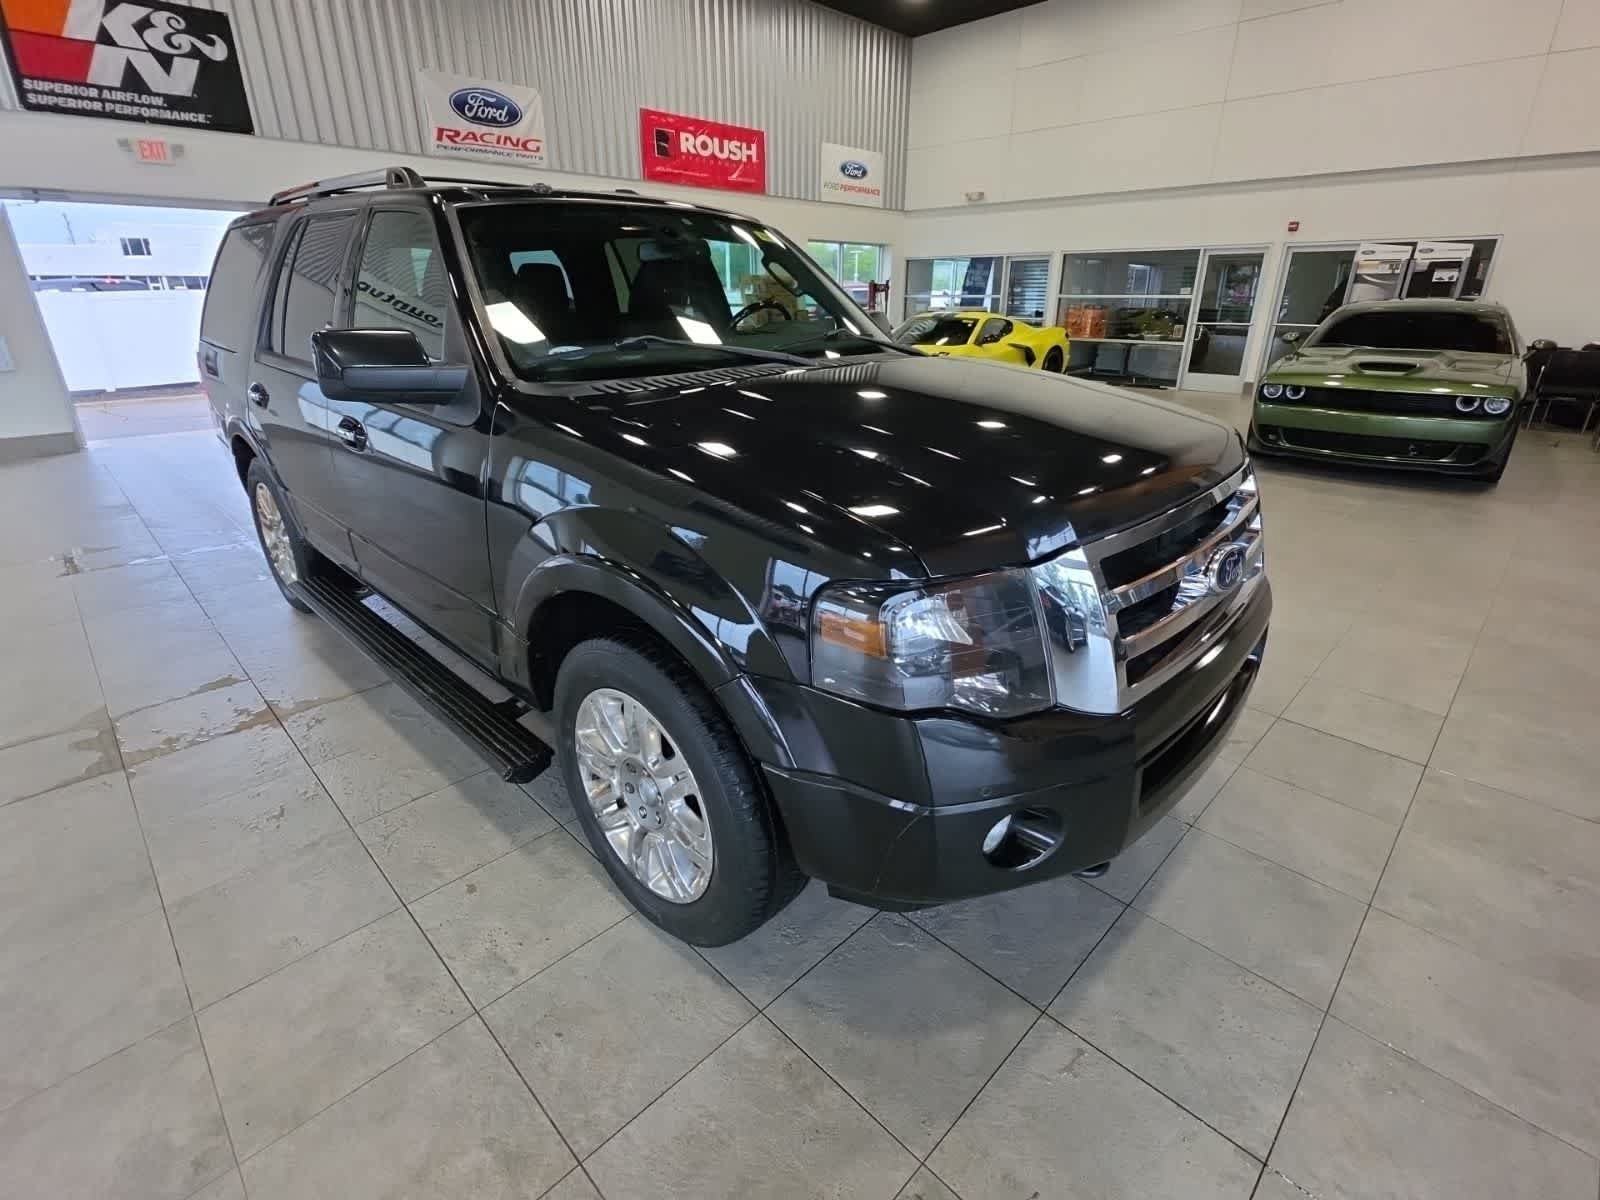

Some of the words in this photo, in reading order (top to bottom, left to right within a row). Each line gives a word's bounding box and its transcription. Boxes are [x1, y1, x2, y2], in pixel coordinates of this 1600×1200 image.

[62, 0, 229, 97] K&N
[22, 79, 99, 98] SUPERIOR
[101, 89, 168, 107] AIRFLOW.
[26, 93, 103, 112] SUPERIOR
[464, 92, 509, 123] Ford
[138, 141, 166, 160] EXIT
[436, 127, 543, 153] RACING
[437, 144, 513, 158] PERFORMANCE
[680, 131, 757, 163] ROUSH
